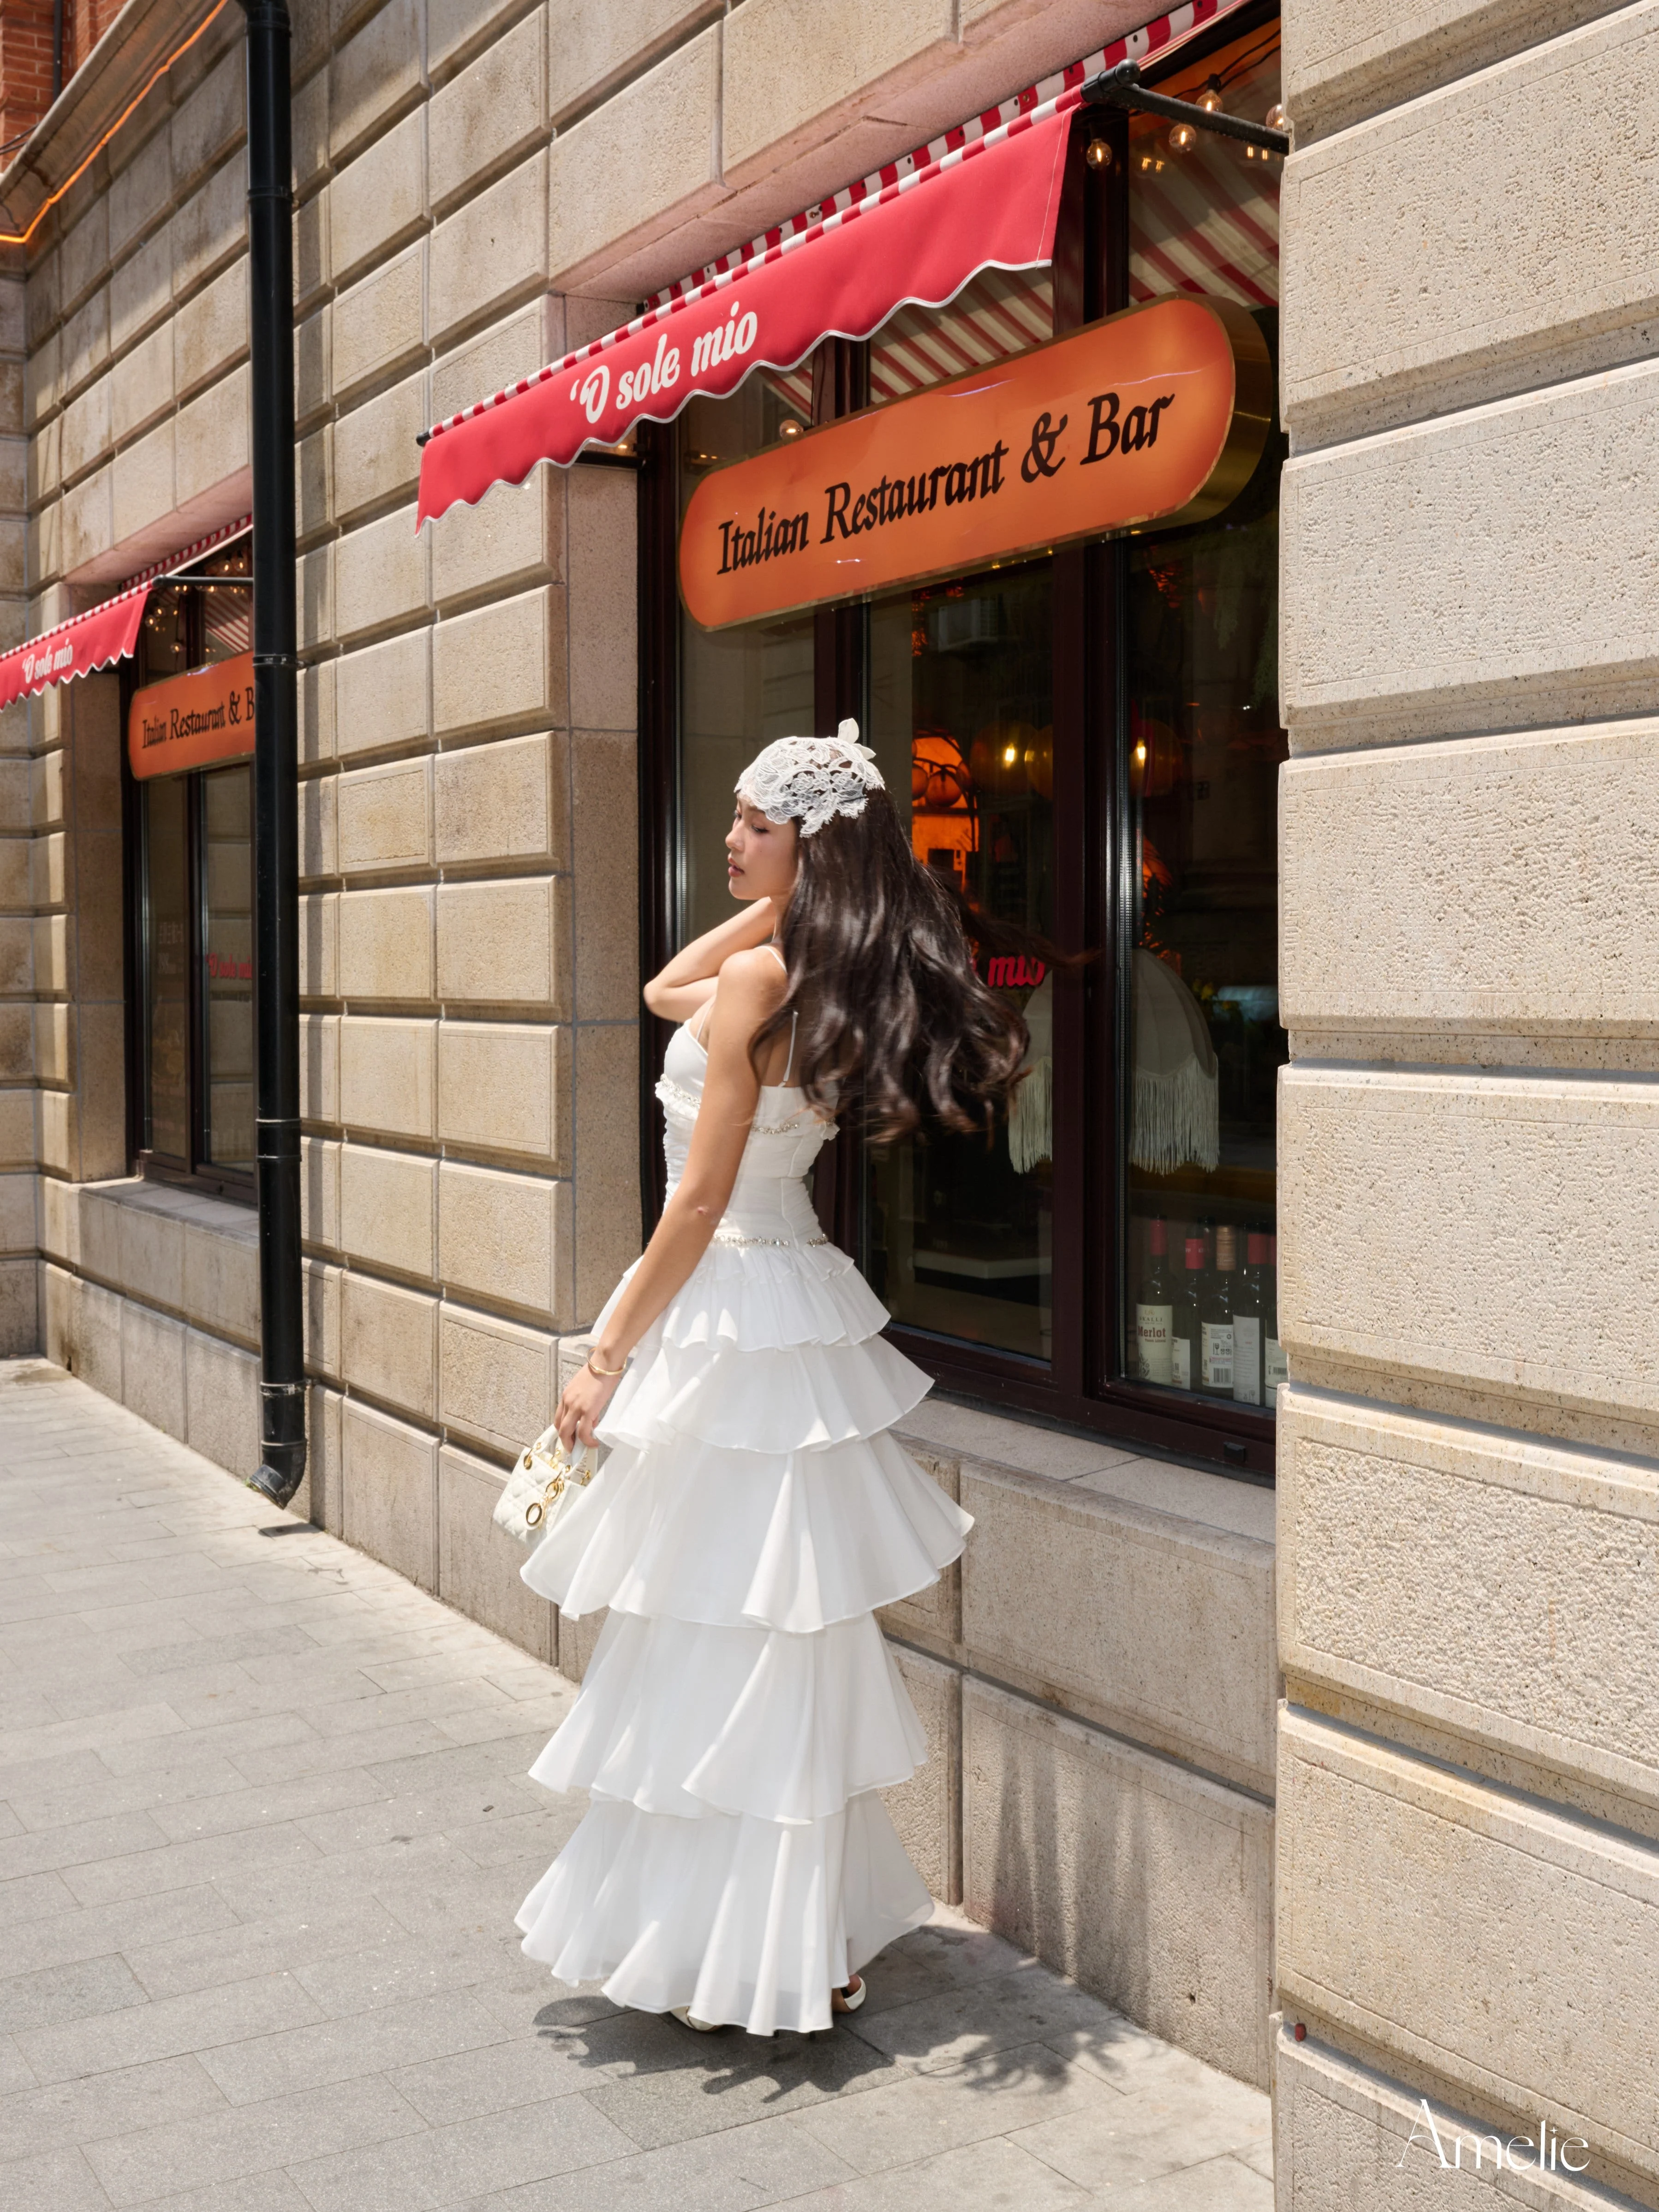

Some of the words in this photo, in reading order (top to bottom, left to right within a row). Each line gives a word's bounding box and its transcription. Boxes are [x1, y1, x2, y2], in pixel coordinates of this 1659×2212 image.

[616, 334, 680, 410] sole
[691, 301, 758, 377] mio
[717, 507, 809, 575] Italian
[820, 440, 1009, 544] Restaurant
[1020, 412, 1068, 483] &
[1080, 392, 1175, 465] Bar
[35, 643, 53, 680] sole
[53, 637, 73, 671] mio
[142, 715, 167, 749] Italian
[169, 704, 226, 740] Restaurant
[229, 690, 242, 726] &
[239, 955, 252, 979] mi
[1137, 1325, 1166, 1338] Merlot
